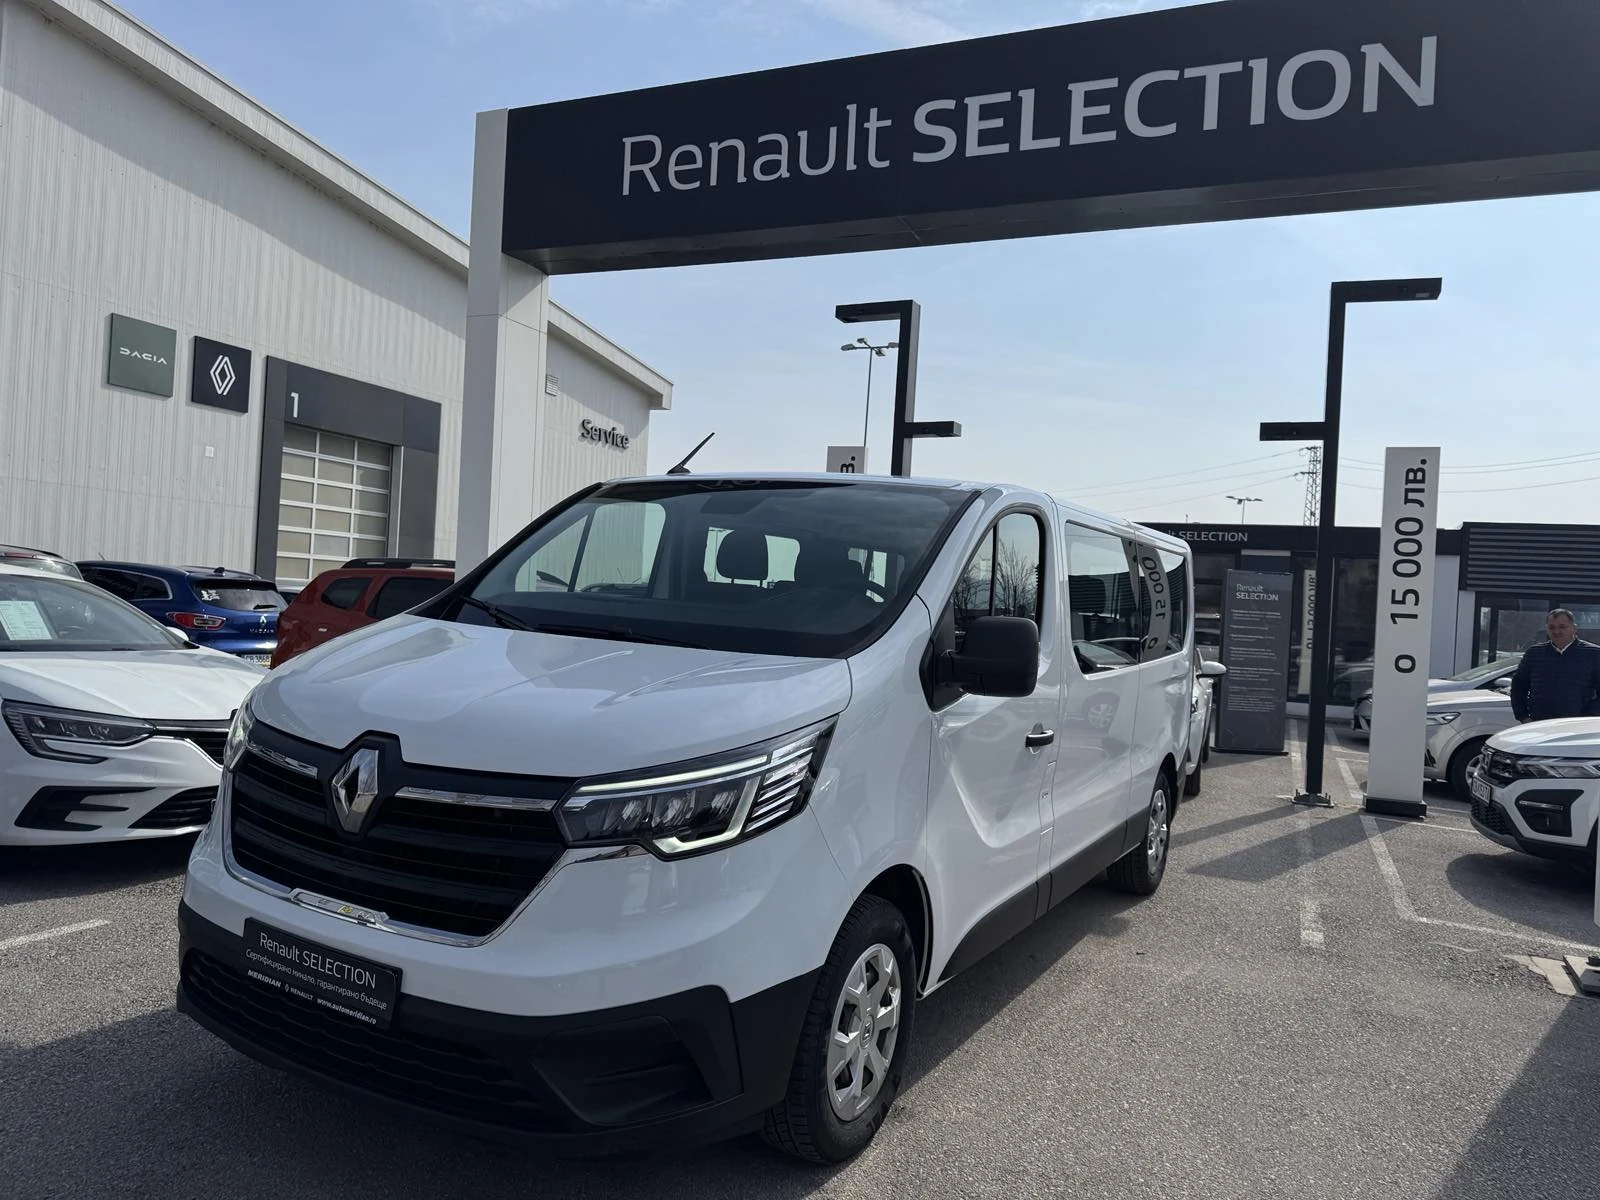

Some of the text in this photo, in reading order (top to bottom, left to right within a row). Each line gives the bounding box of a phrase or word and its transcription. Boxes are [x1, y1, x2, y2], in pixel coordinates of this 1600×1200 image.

[621, 35, 1437, 196] Renault SELECTION
[119, 347, 168, 365] DACIA
[290, 392, 300, 418] 1
[581, 418, 630, 450] Service
[1404, 458, 1428, 508] лв.
[1179, 530, 1248, 542] SELECTION
[1392, 517, 1424, 578] 000
[1236, 592, 1279, 601] SELECTION
[1390, 588, 1420, 625] 15
[260, 932, 376, 990] Renault SELECTION
[245, 948, 292, 974] Сертифицирано
[316, 979, 360, 999] гарантирано
[360, 992, 387, 1010] бъдеще
[247, 969, 282, 988] MERIDIAN
[290, 987, 314, 1000] RENAULT
